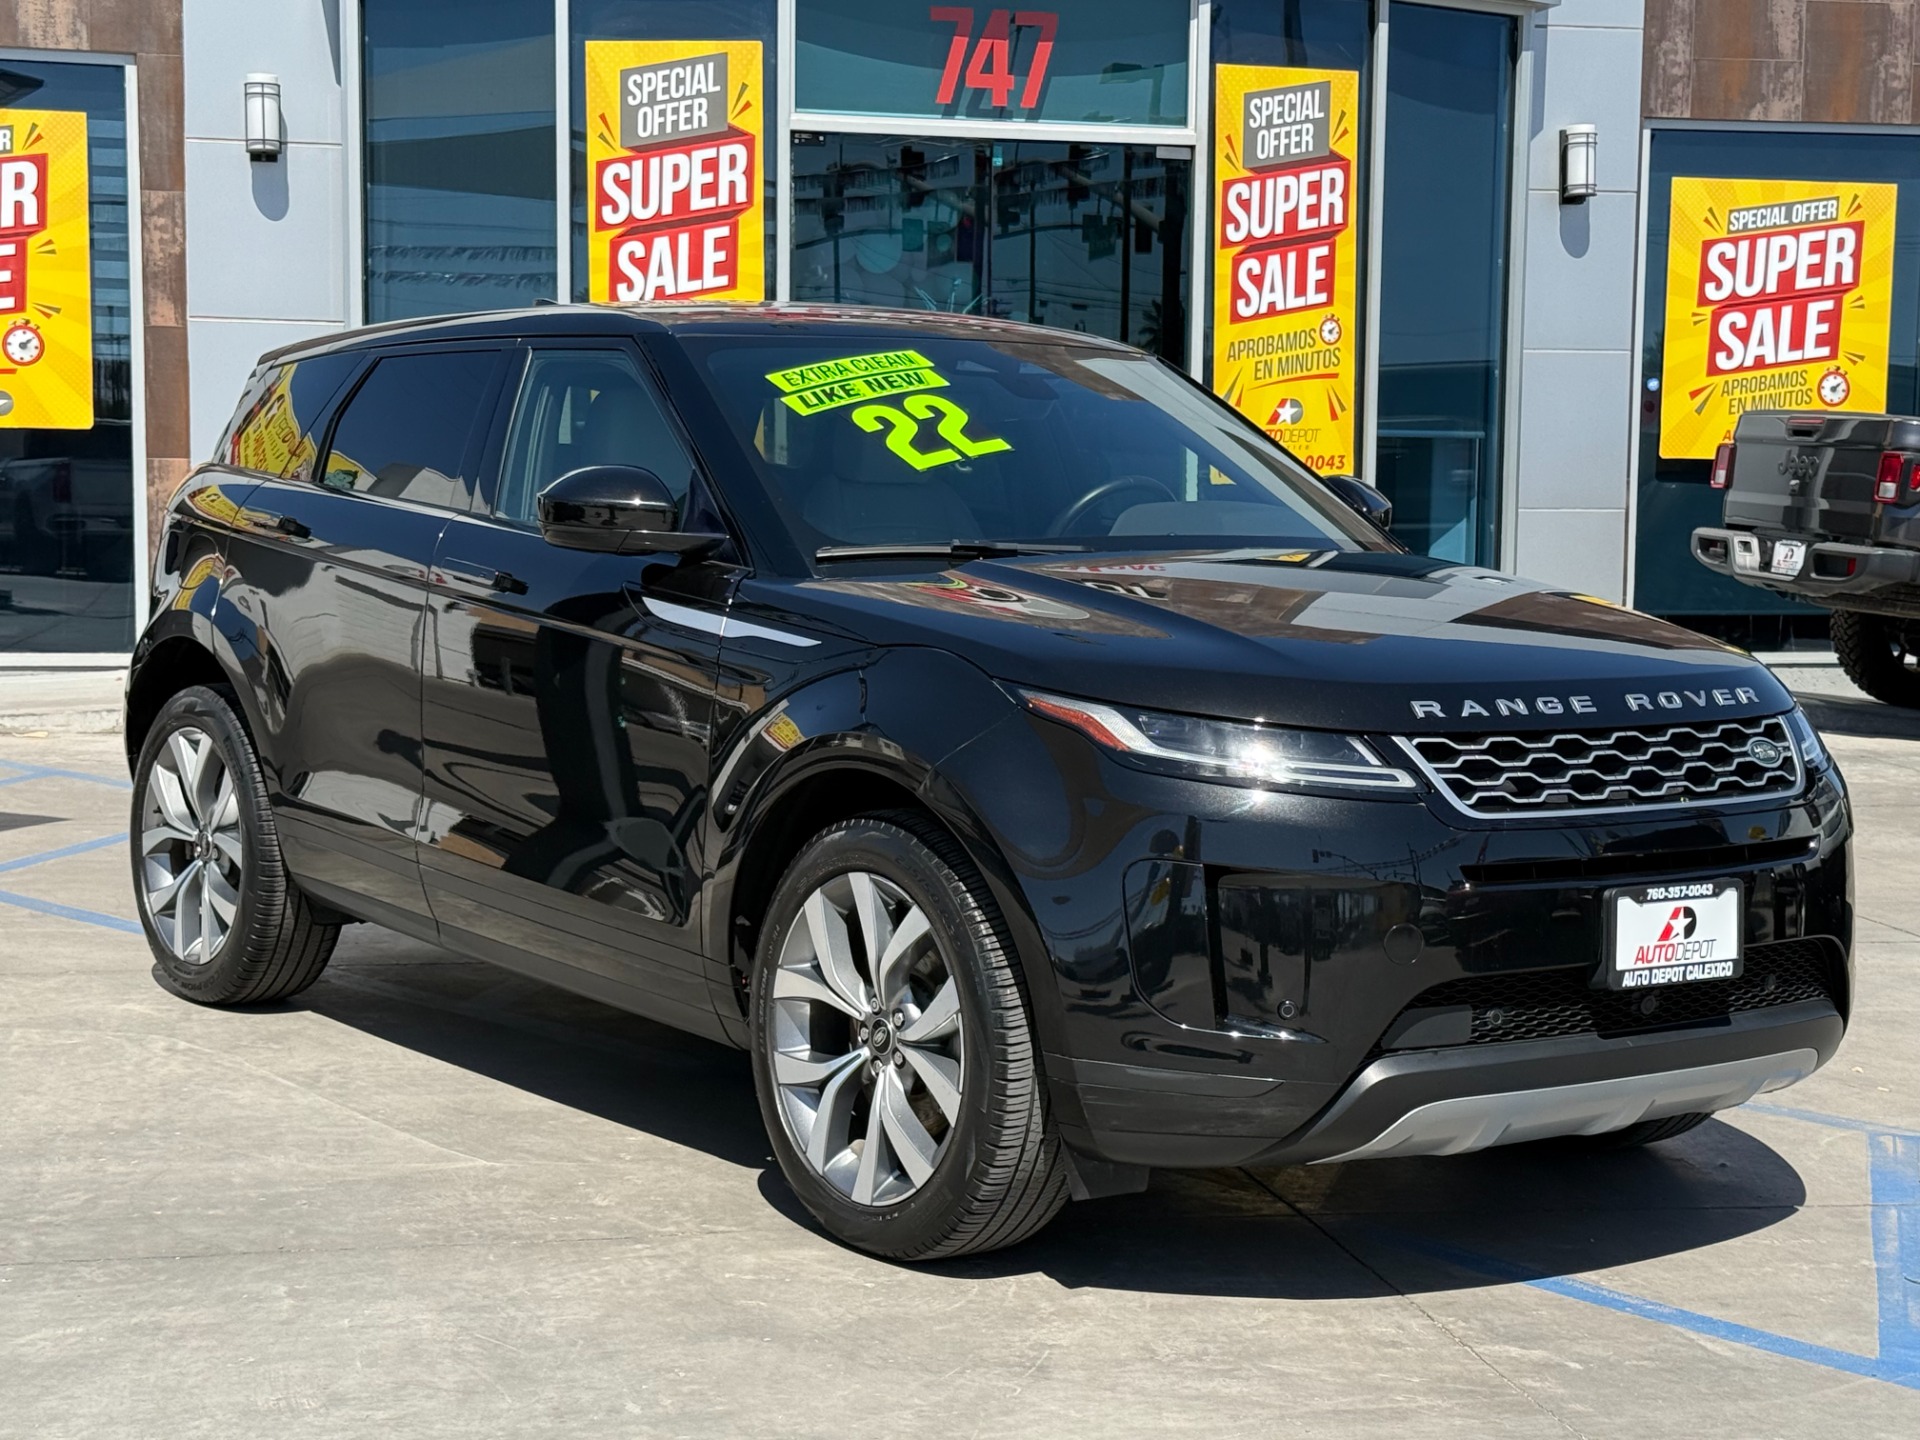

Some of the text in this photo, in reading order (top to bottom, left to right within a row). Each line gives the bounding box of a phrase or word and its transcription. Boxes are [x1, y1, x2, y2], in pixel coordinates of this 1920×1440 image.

[930, 6, 1059, 108] 747
[627, 61, 721, 107] SPECIAL
[637, 97, 708, 138] OFFER
[1248, 89, 1324, 129] SPECIAL
[1256, 123, 1314, 160] OFFER
[601, 143, 748, 225] SUPER
[1225, 167, 1345, 243] SUPER
[1729, 199, 1838, 231] SPECIAL OFFER
[616, 225, 732, 301] SALE
[1236, 245, 1330, 318] SALE
[1704, 227, 1856, 301] SUPER
[1226, 328, 1316, 362] APROBAMOS
[1714, 299, 1835, 371] SALE
[781, 352, 915, 387] EXTRA CLEAN
[1254, 347, 1341, 381] EN MINUTOS
[796, 371, 926, 410] LIKE NEW
[1721, 369, 1808, 397] APROBAMOS
[1728, 388, 1812, 415] EN MINUTOS
[851, 394, 1012, 471] 22
[1265, 427, 1322, 443] TODEPOT
[1776, 447, 1819, 480] Jeep
[1409, 686, 1760, 719] RANGE ROVER
[1646, 883, 1714, 901] 760-357-0043
[1633, 938, 1717, 966] AUTODEPOT
[1622, 961, 1733, 988] AUTO DEPOT CALEXICO
